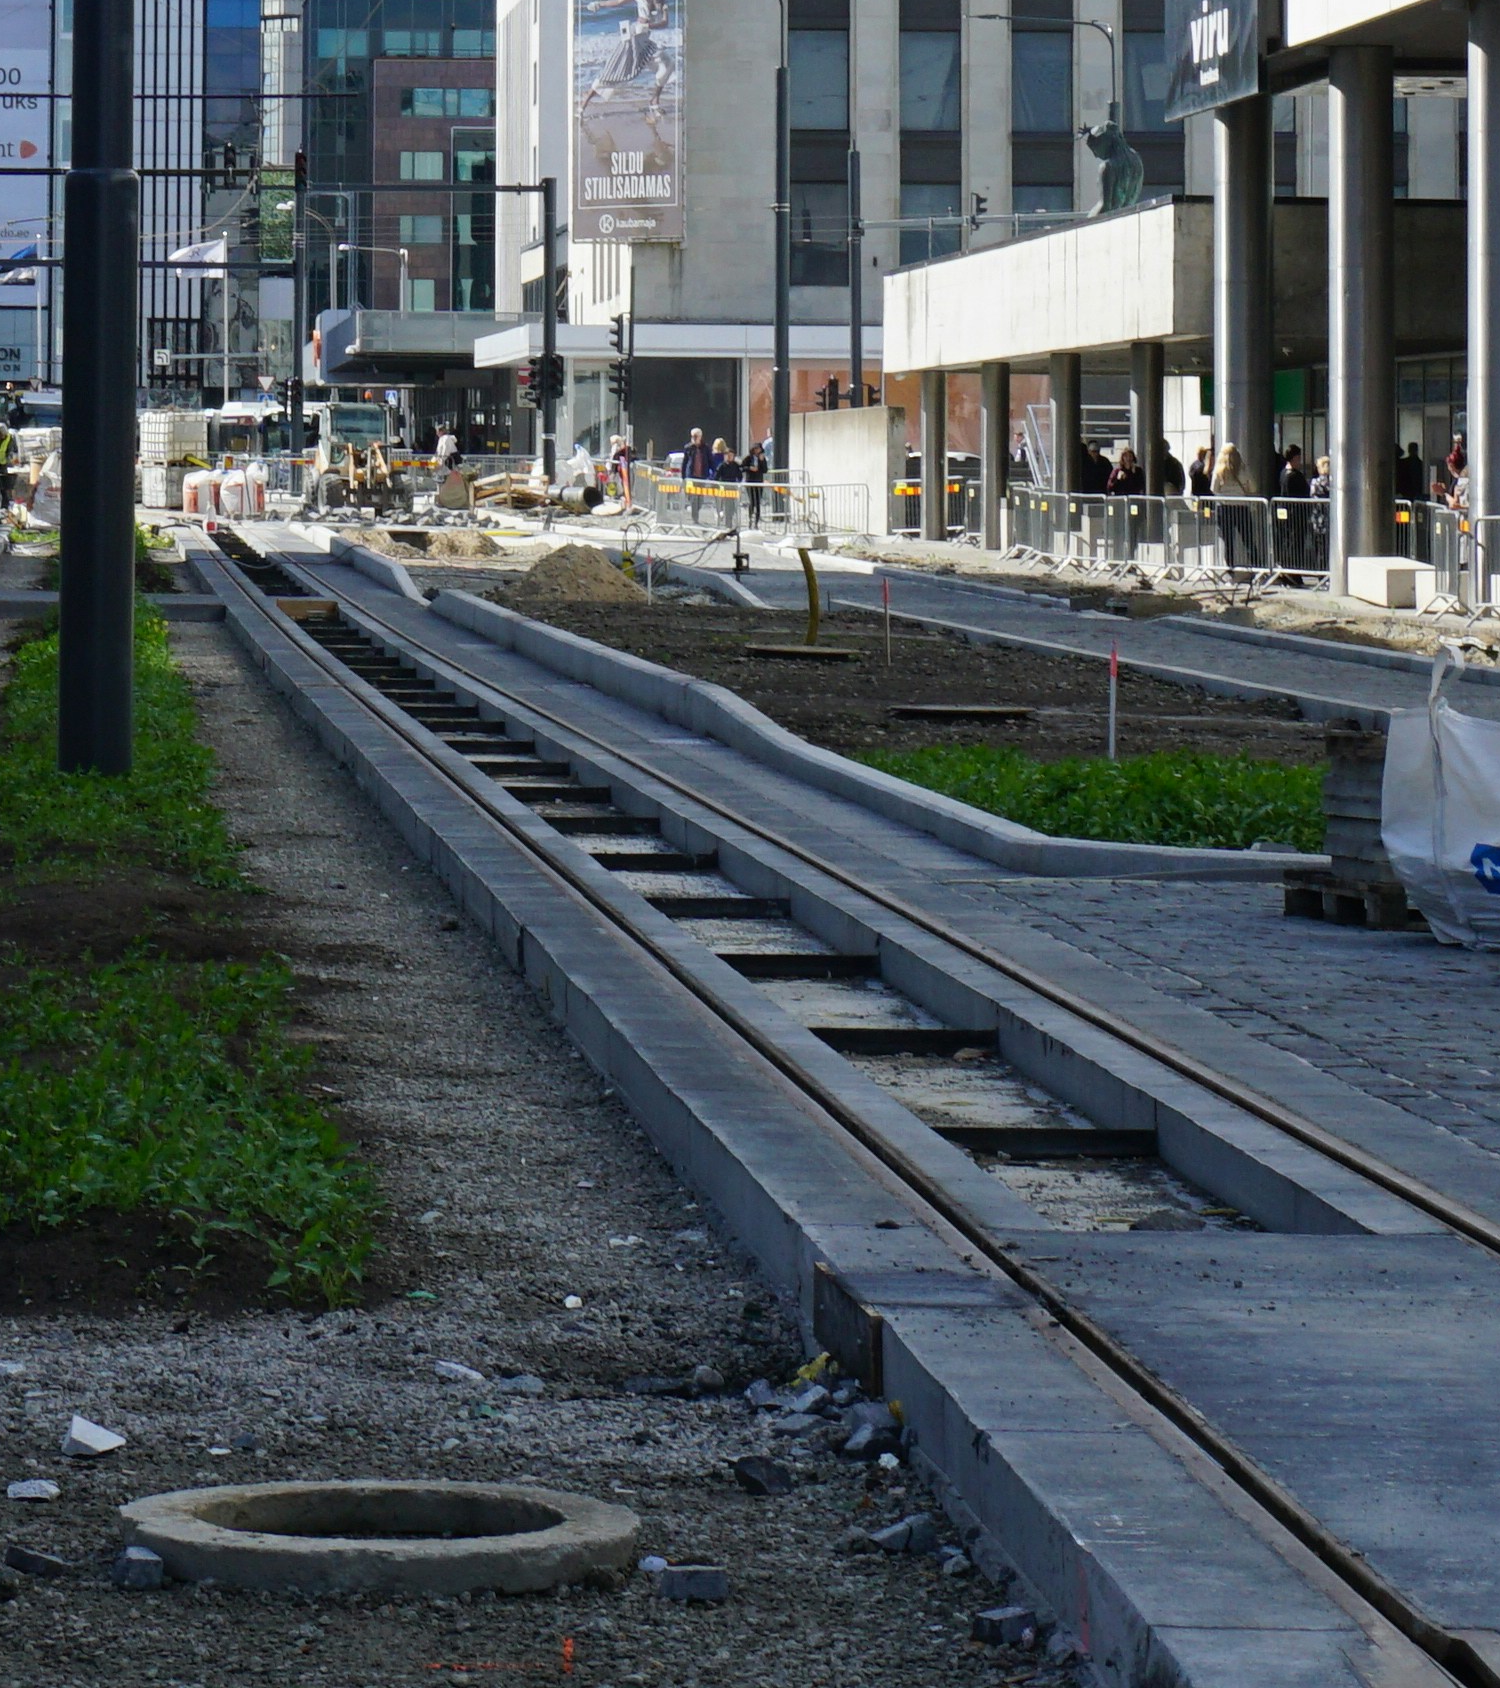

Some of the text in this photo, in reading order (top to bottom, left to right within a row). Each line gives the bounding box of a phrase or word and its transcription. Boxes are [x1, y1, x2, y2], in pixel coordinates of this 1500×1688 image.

[1190, 0, 1229, 65] viru
[611, 150, 644, 176] SILDU
[584, 174, 671, 201] STIILISADAMAS
[616, 217, 657, 230] kaubamaja
